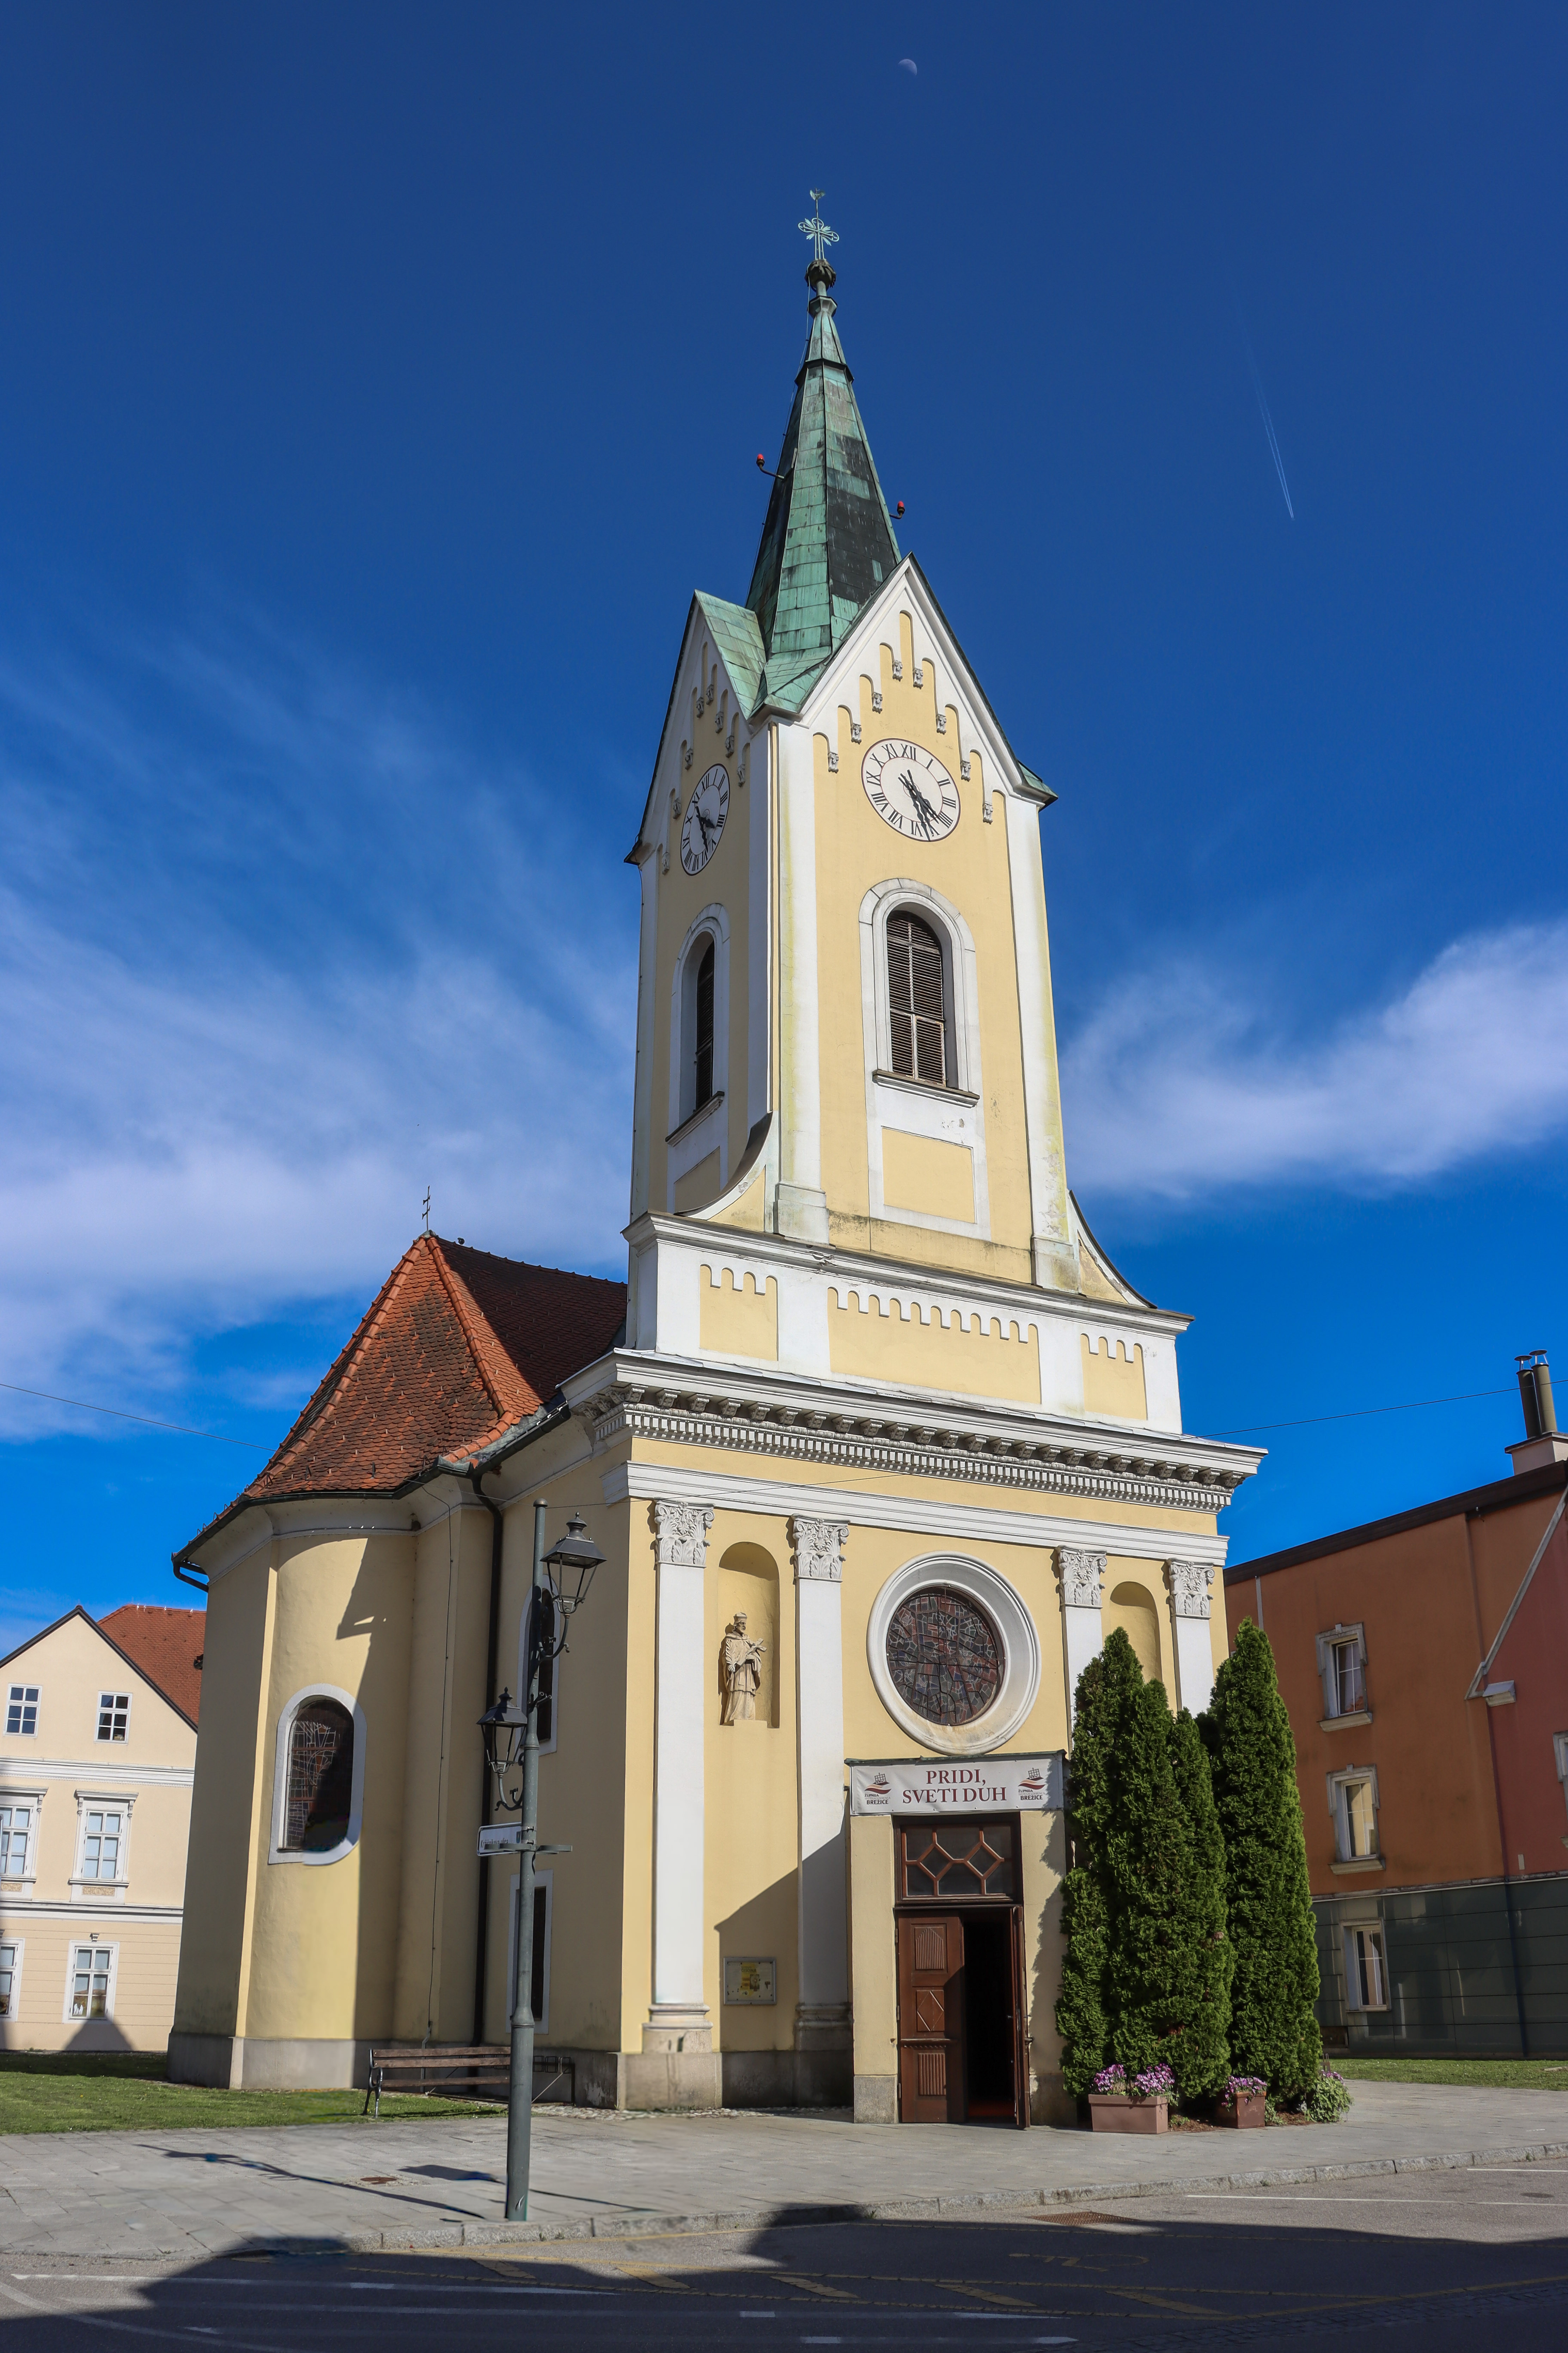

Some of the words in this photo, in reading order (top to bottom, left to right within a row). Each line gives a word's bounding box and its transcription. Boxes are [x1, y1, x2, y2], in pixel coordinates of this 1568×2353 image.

[870, 753, 885, 767] X
[881, 743, 899, 760] XI
[900, 743, 916, 761] XII
[926, 758, 934, 769] I
[866, 770, 881, 786] IX
[938, 778, 951, 787] II
[871, 792, 889, 813] VIII
[942, 797, 957, 809] III
[887, 810, 903, 829] VII
[938, 811, 954, 829] IIII
[910, 820, 923, 837] VI
[926, 1769, 986, 1786] PRIDI,
[903, 1788, 958, 1804] SVETI
[962, 1787, 1007, 1802] DUH
